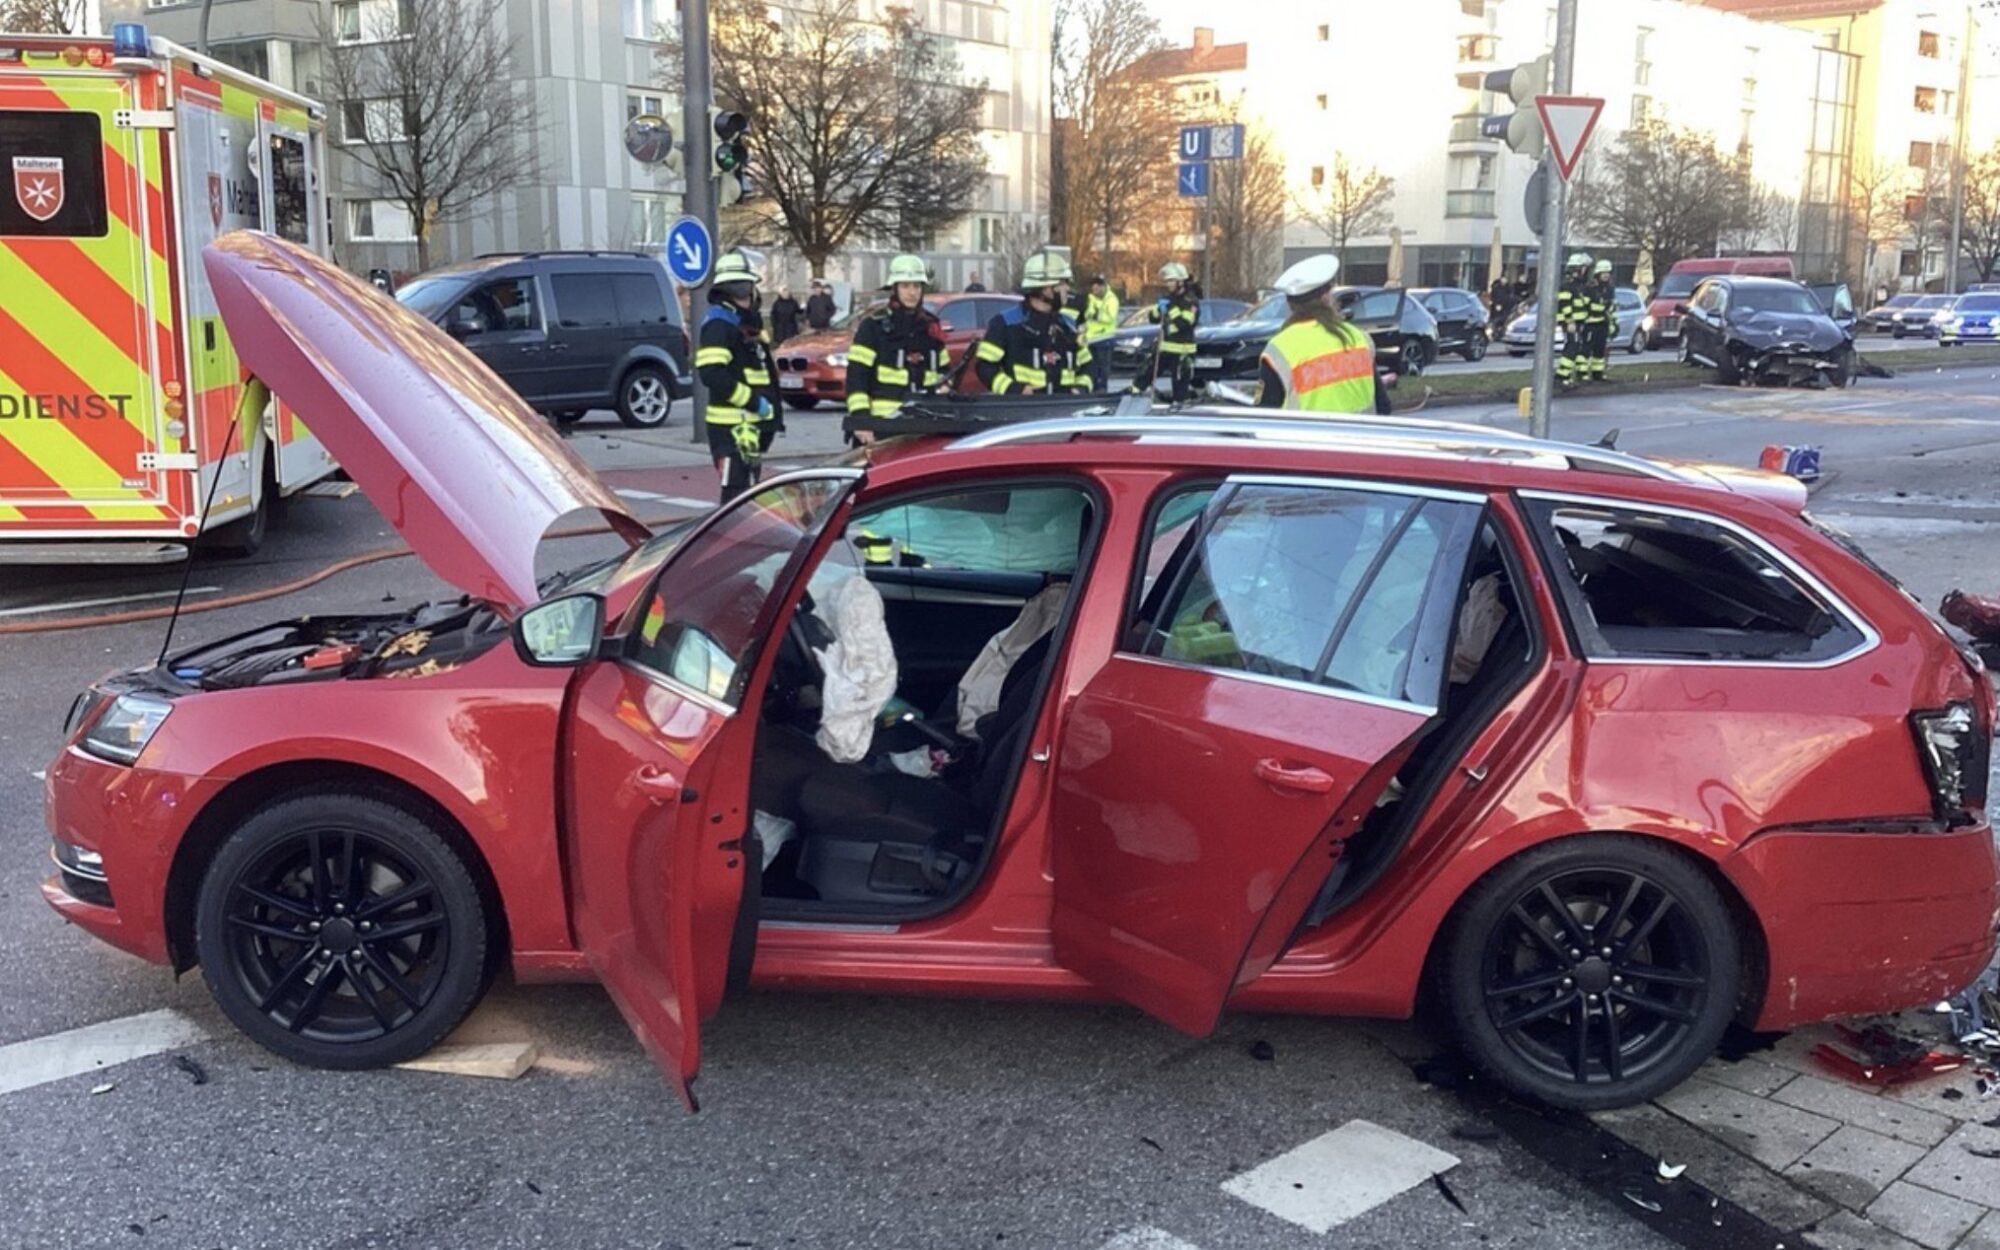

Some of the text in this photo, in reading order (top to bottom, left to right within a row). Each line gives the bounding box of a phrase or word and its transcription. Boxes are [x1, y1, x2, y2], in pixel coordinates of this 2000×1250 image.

[1185, 131, 1199, 155] U
[16, 159, 59, 168] Malteser
[0, 395, 132, 419] DIENST
